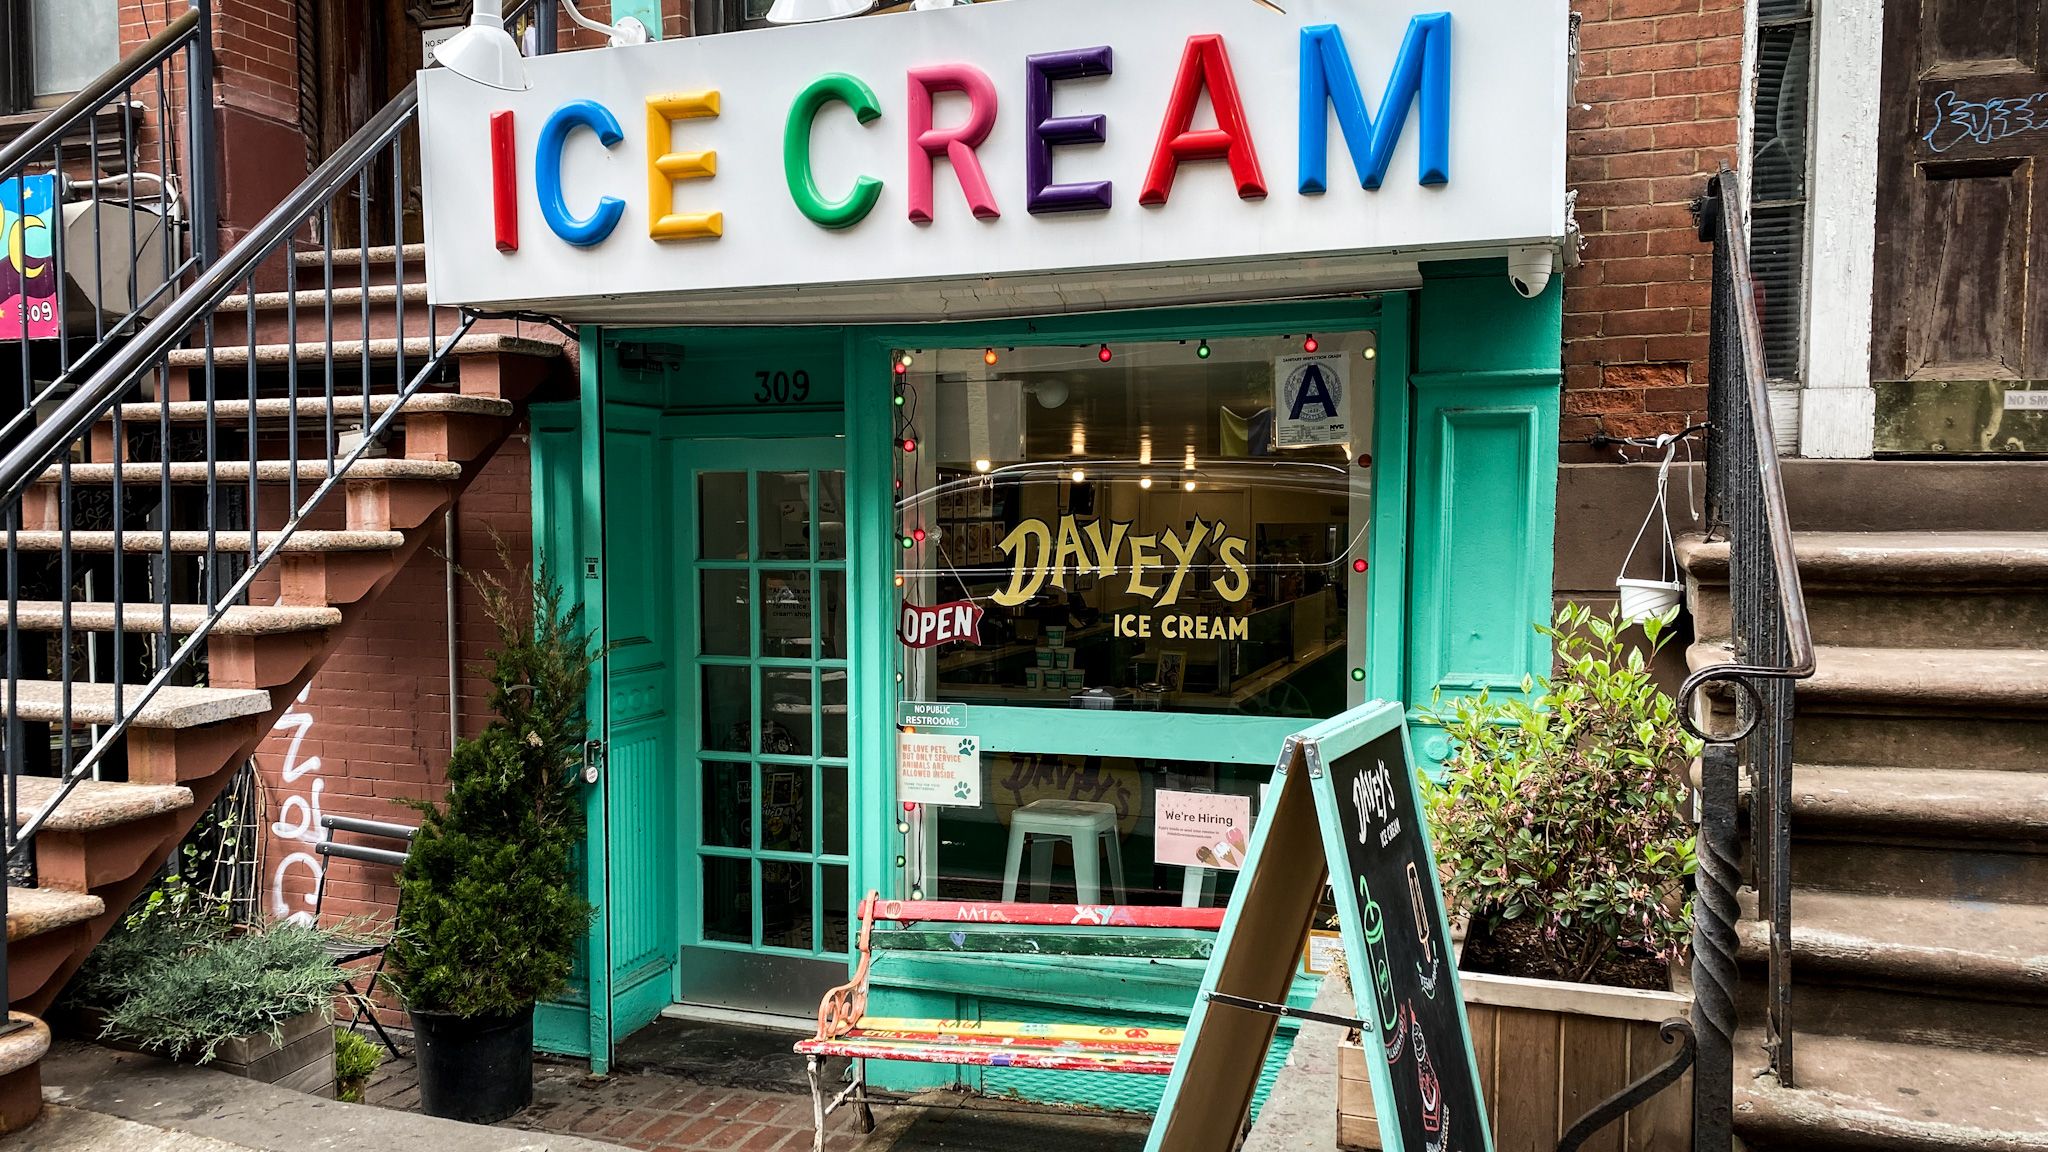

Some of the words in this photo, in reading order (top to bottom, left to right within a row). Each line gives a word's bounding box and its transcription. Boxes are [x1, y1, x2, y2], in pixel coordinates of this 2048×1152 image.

[425, 39, 435, 47] NO
[490, 91, 723, 253] ICE
[784, 11, 1452, 230] CREAM
[754, 370, 810, 403] 309
[1289, 365, 1338, 420] A
[2008, 395, 2025, 405] NO
[991, 514, 1250, 609] DAVEY'S
[903, 606, 973, 645] OPEN
[1114, 614, 1151, 637] ICE
[1161, 614, 1248, 640] CREAM
[914, 705, 925, 714] NO
[926, 705, 950, 714] PUBLIC
[905, 715, 960, 726] RESTROOMS
[902, 744, 911, 752] WE
[913, 744, 928, 753] LOVE
[902, 752, 914, 760] BUT
[916, 753, 932, 761] ONLY
[934, 754, 961, 763] SERVICE
[902, 761, 930, 770] ANIMALS
[932, 762, 945, 770] ARE
[902, 769, 931, 778] ALLOWED
[1353, 758, 1395, 844] DAVEY'S
[1165, 810, 1195, 822] We're
[1198, 813, 1233, 827] Hiring
[1380, 828, 1389, 848] ICE
